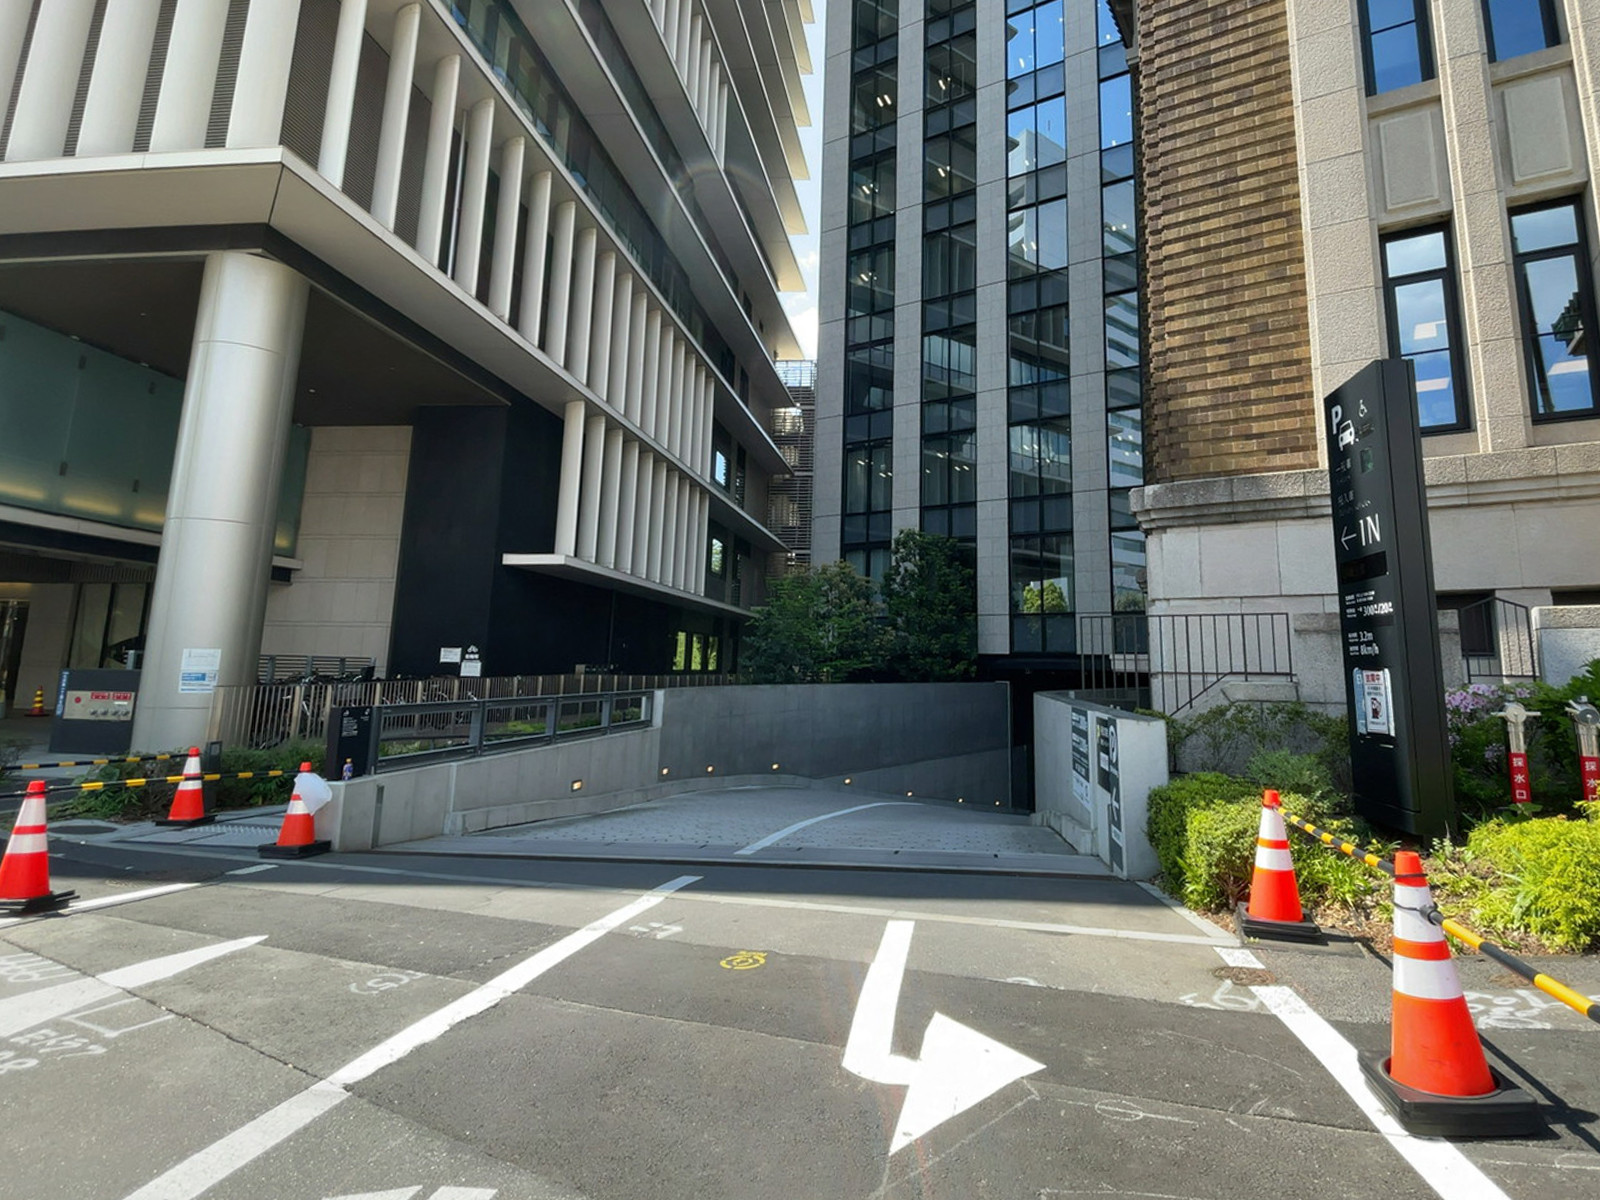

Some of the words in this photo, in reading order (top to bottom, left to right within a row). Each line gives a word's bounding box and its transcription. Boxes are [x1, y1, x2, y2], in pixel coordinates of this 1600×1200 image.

[1331, 405, 1342, 435] P
[1359, 513, 1381, 547] IN
[1513, 757, 1527, 799] 採水口
